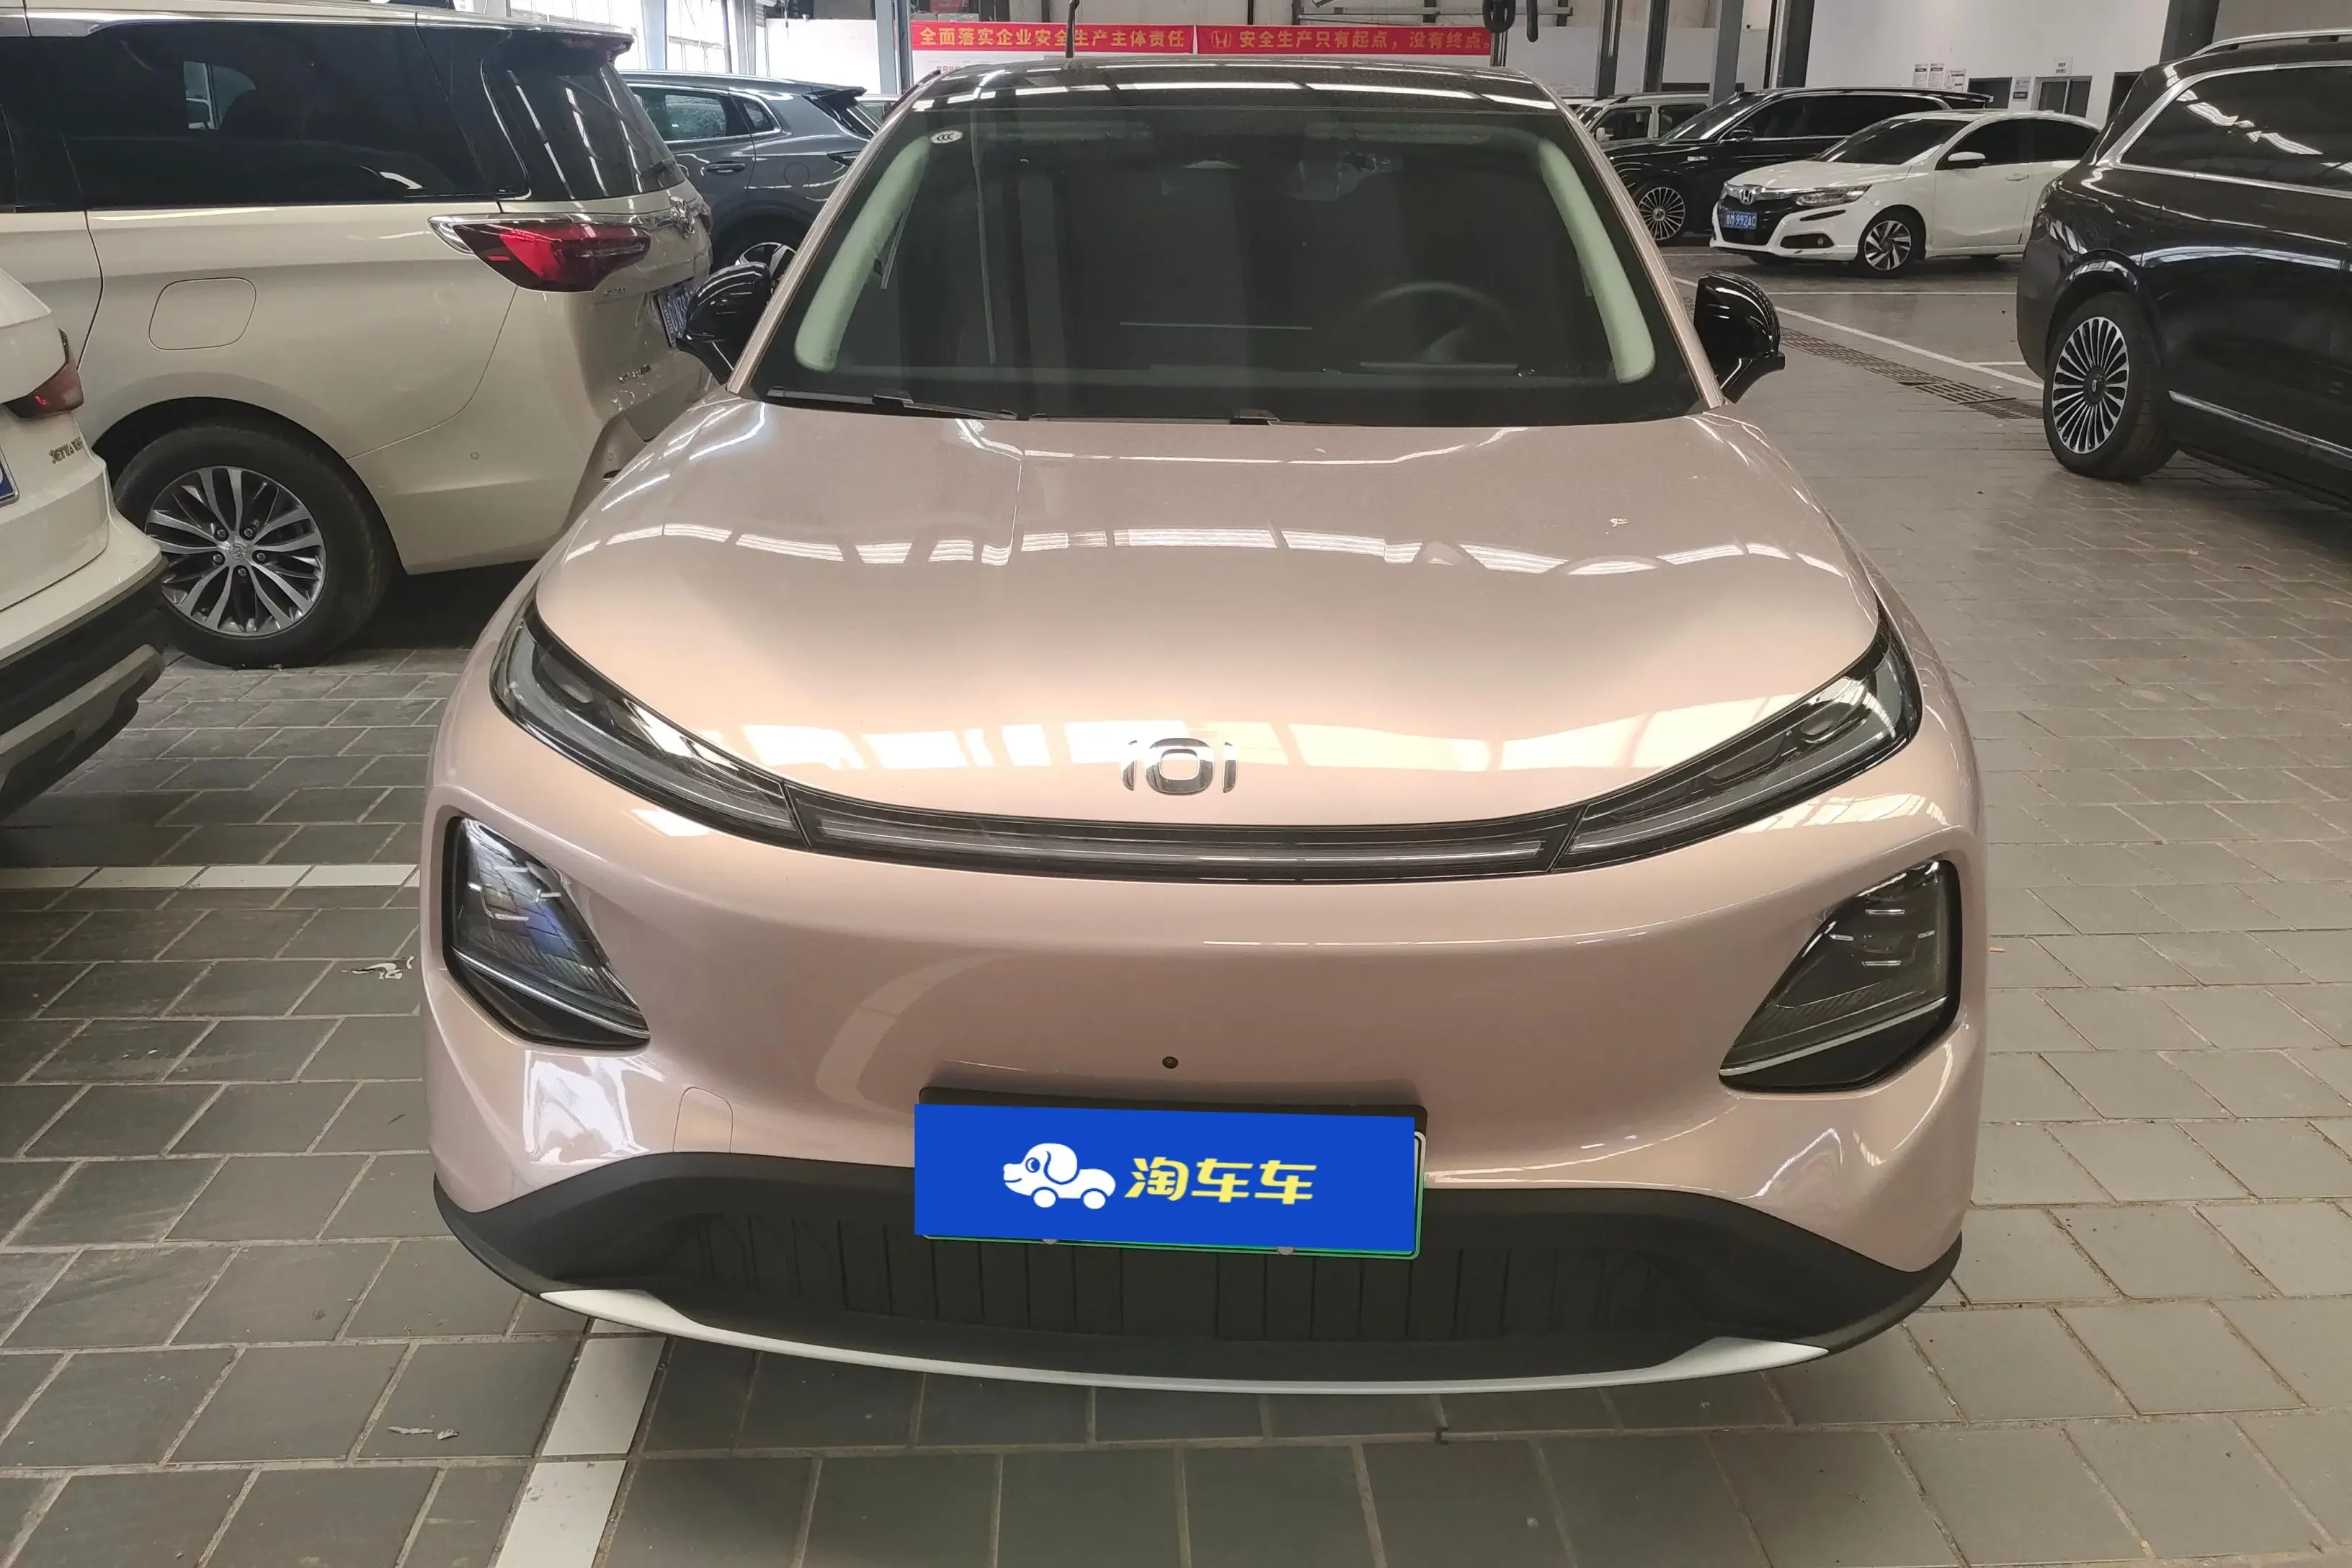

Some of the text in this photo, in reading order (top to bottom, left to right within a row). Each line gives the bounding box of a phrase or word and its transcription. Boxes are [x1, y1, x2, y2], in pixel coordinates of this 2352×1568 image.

[919, 27, 1184, 48] 全面落实企业安全生产主体责任
